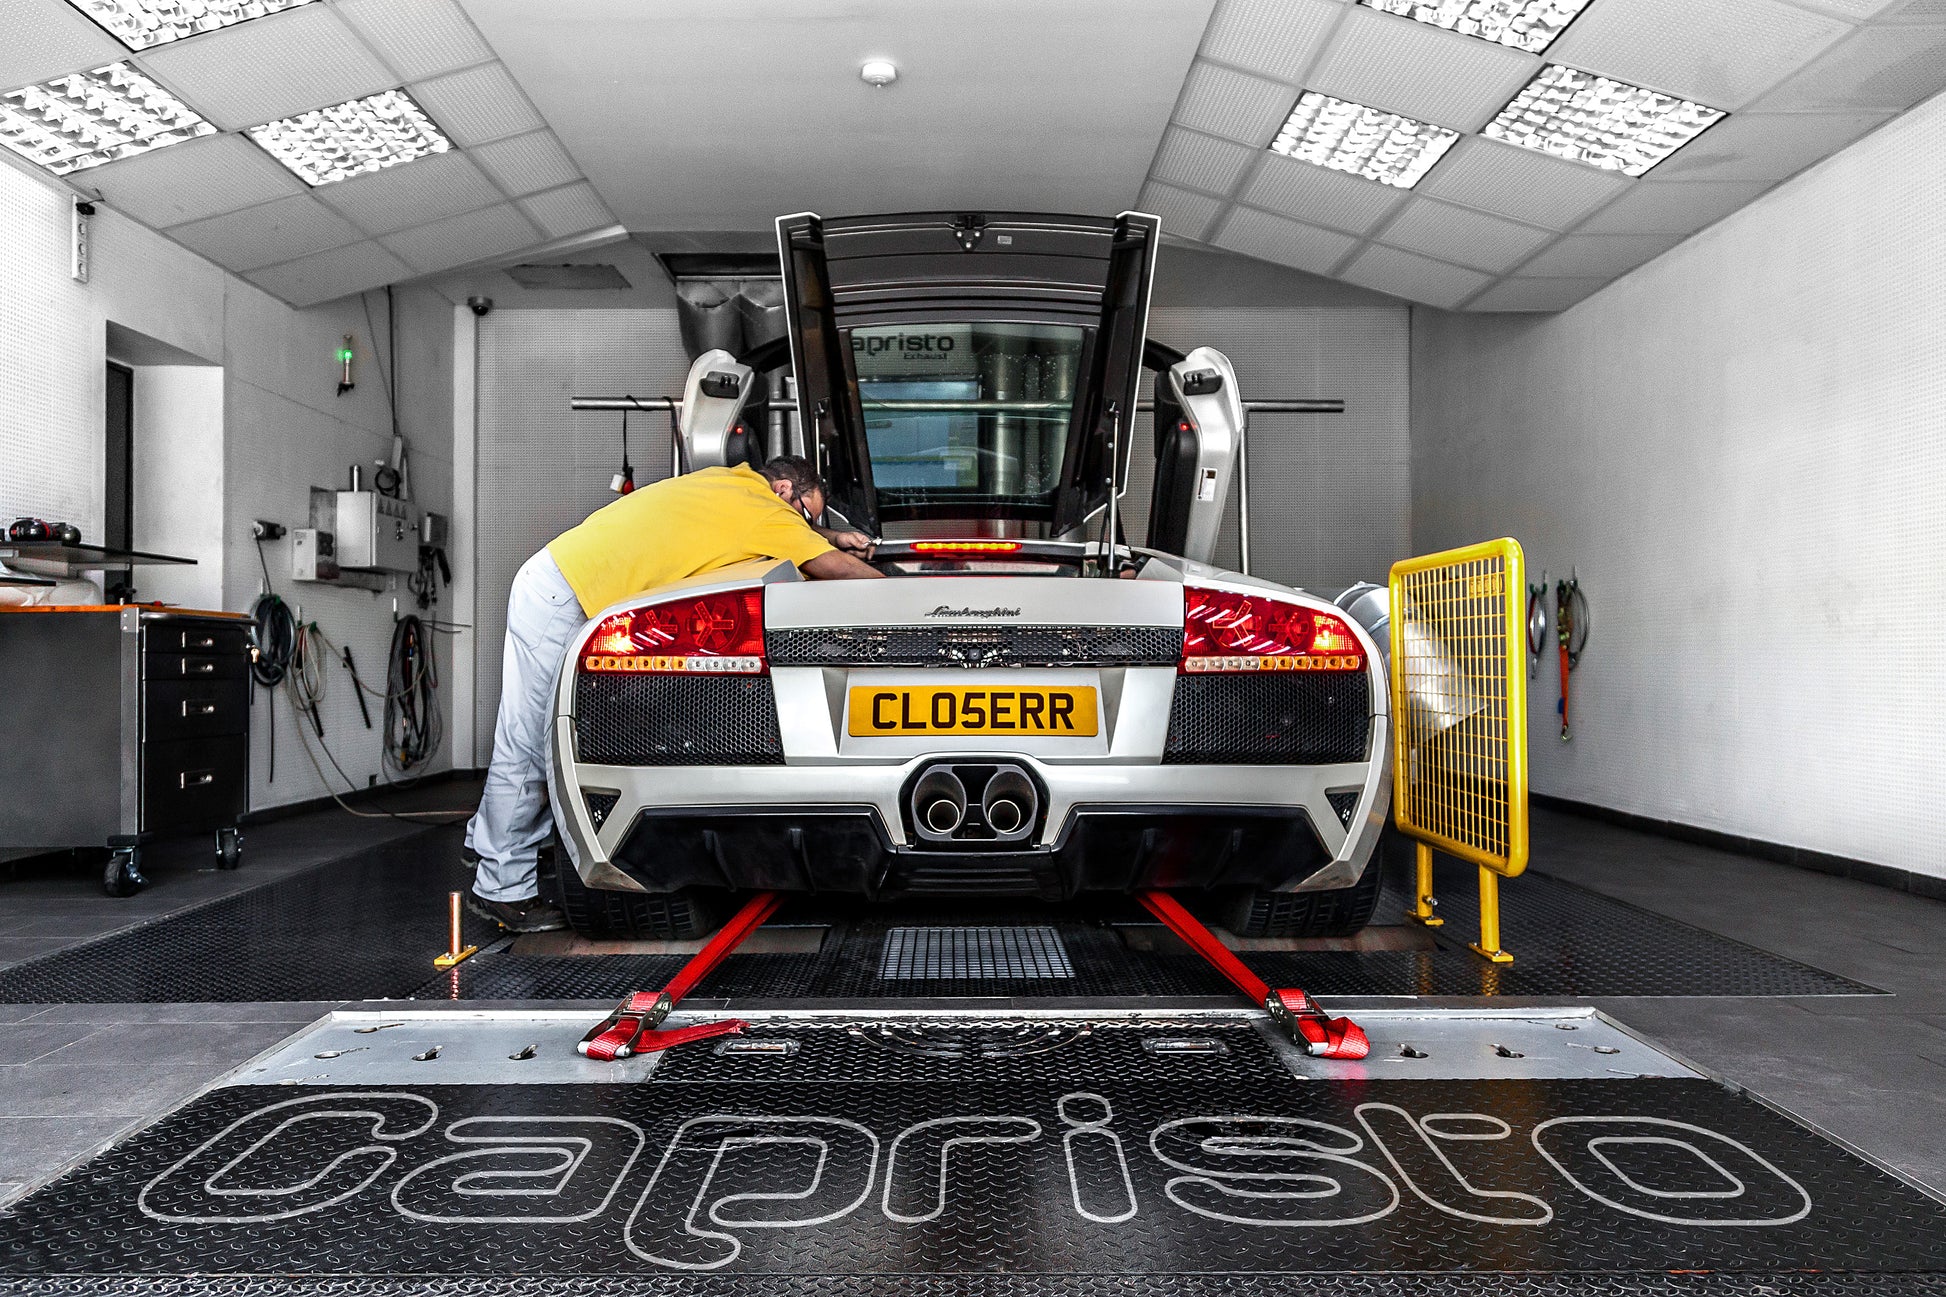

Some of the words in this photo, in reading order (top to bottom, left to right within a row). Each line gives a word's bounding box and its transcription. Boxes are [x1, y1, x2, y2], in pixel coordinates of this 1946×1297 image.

[852, 332, 954, 356] apristo
[903, 352, 948, 360] Exhaust
[924, 605, 1021, 619] Lamborghini
